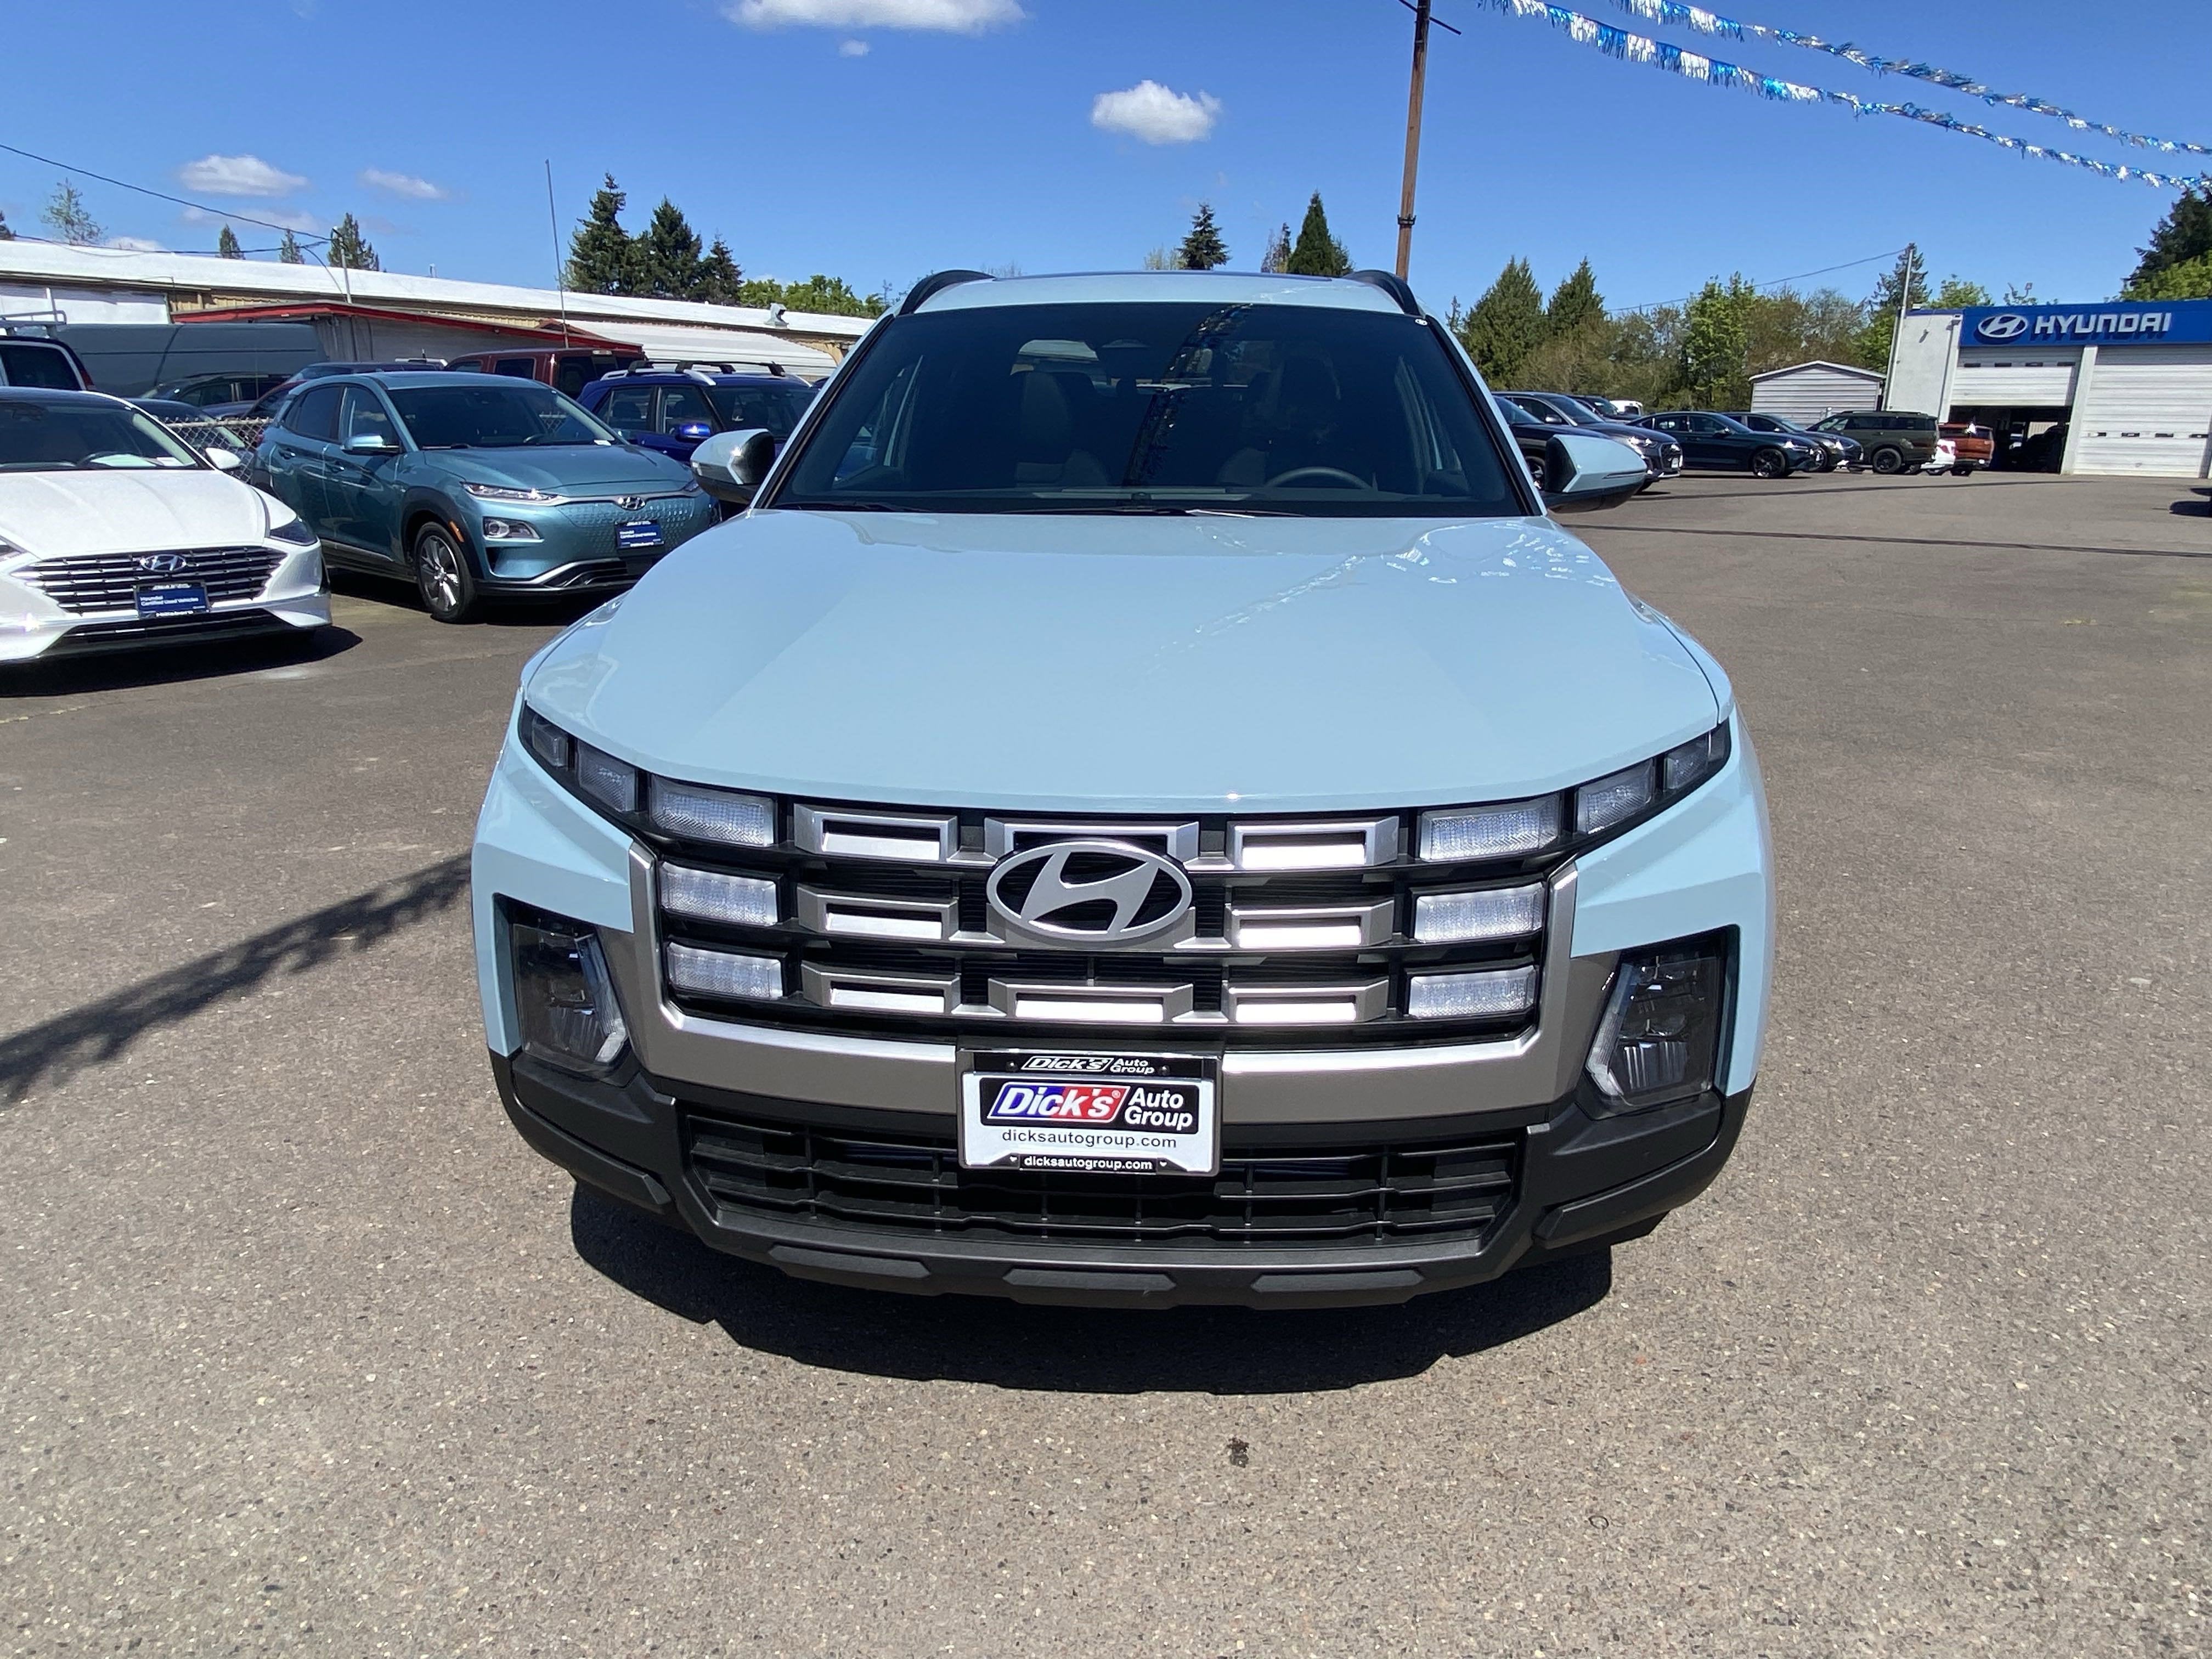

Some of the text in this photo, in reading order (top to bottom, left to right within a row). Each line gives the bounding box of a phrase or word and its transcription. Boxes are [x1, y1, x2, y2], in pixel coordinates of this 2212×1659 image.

[2034, 312, 2172, 334] HYUNDAI
[1110, 1065, 1155, 1075] Group
[1113, 1058, 1149, 1066] Auto
[1128, 1087, 1183, 1109] Auto
[1125, 1105, 1193, 1131] Group
[1002, 1128, 1177, 1148] dicksautogroup.com
[1024, 1156, 1153, 1170] dicksautogroup.com
